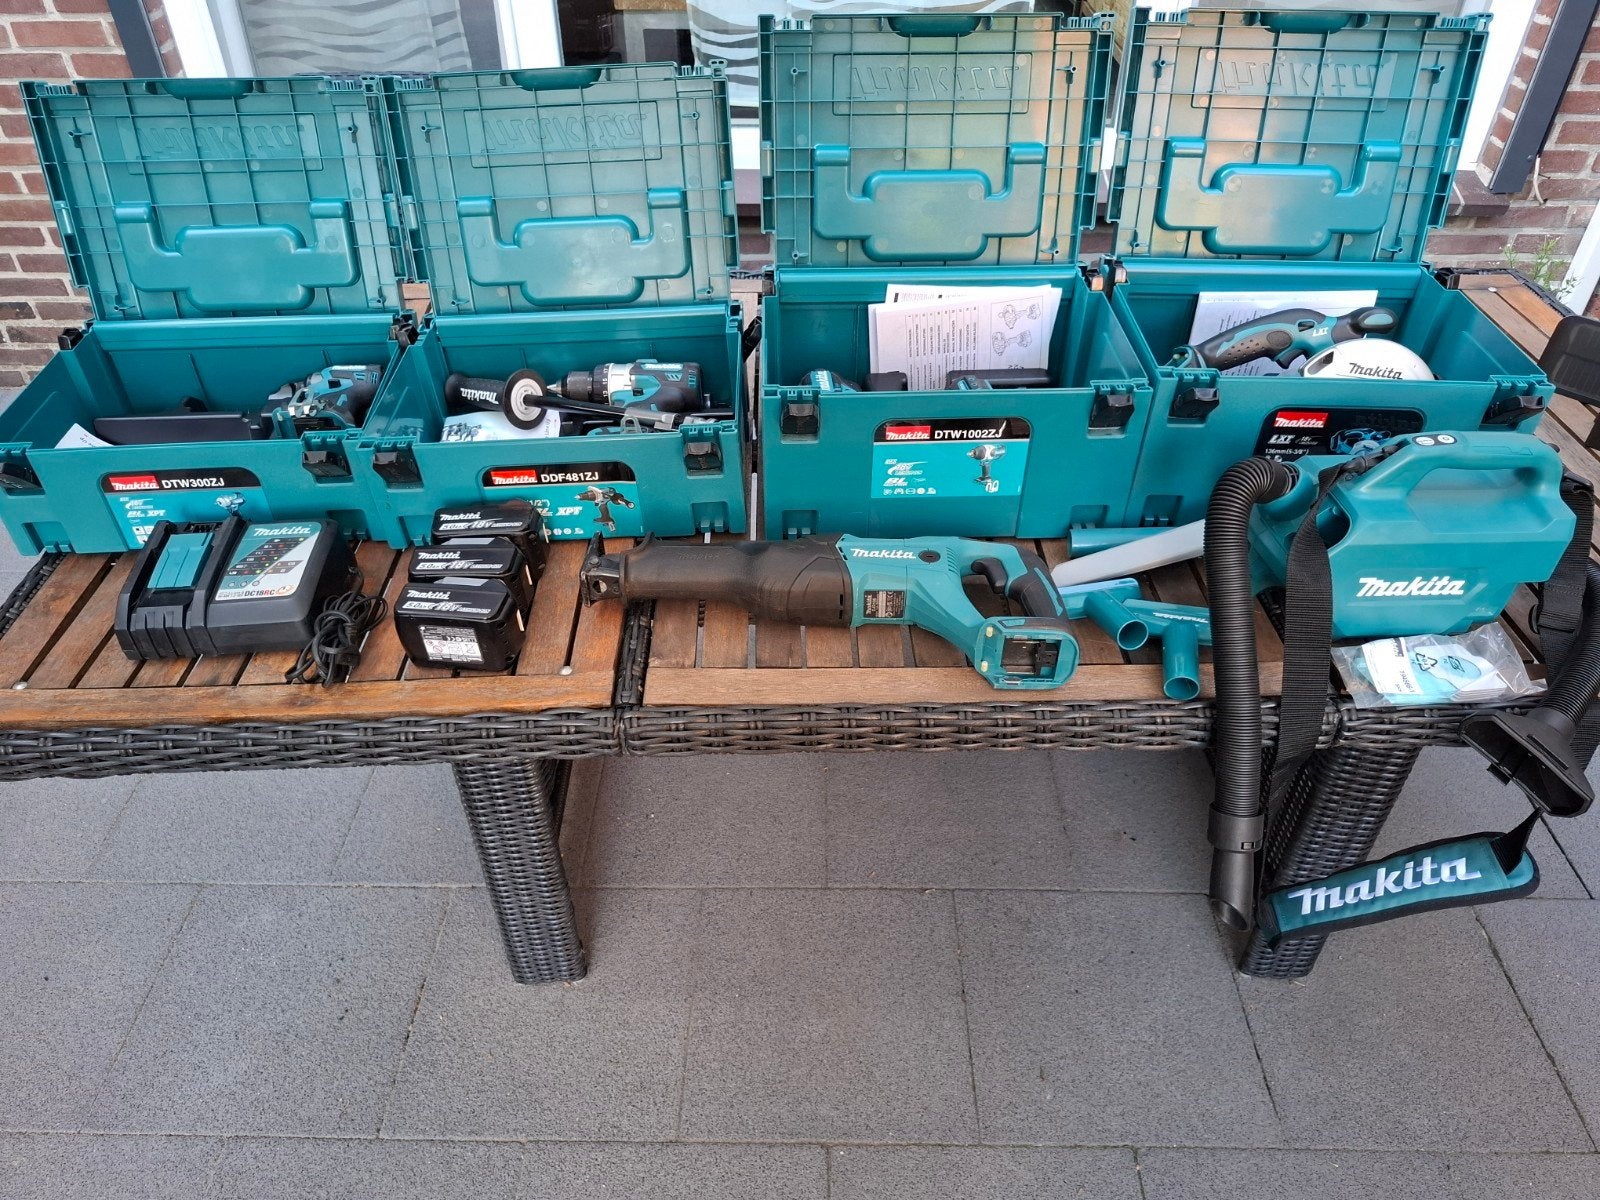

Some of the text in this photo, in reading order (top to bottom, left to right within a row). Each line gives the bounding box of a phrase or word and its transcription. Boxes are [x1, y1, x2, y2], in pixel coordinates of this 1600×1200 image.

[934, 428, 1003, 440] DTW1002ZJ
[541, 472, 599, 483] DDF481ZJ
[161, 478, 225, 489] DTW300ZJ
[244, 588, 276, 597] DC18RC
